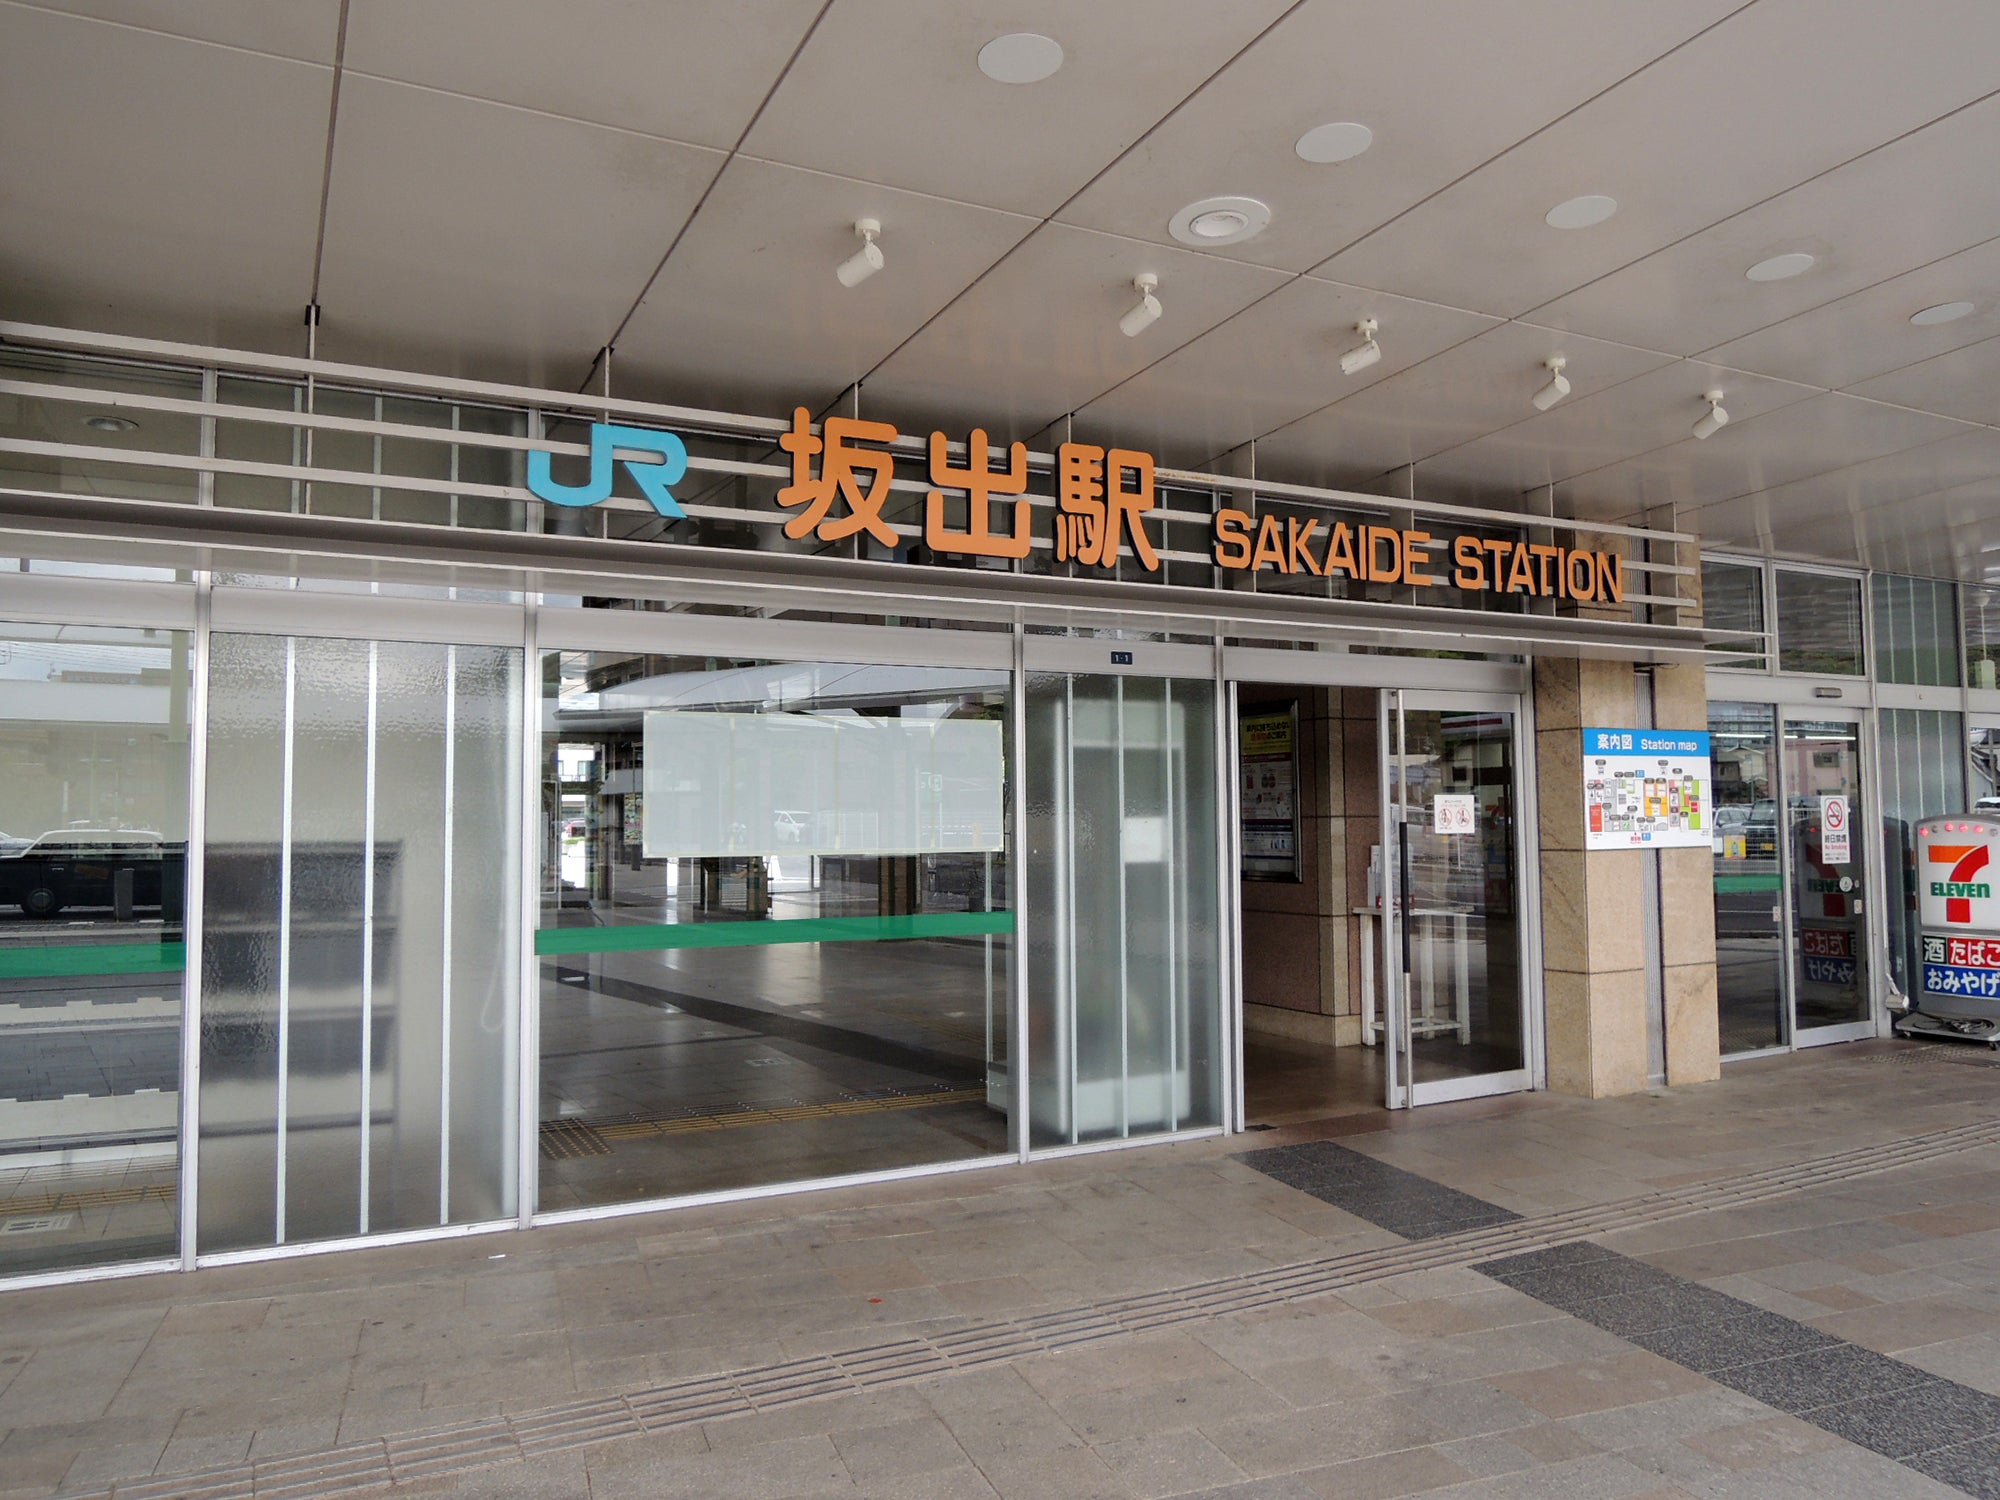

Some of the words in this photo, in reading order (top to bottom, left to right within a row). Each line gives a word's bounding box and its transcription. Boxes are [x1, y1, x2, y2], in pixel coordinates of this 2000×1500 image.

[527, 423, 688, 519] JR
[775, 406, 1160, 572] 坂出駅
[1213, 508, 1432, 586] SAKAIDE
[1452, 535, 1622, 603] STATION
[1597, 734, 1632, 750] 案内図
[1641, 739, 1676, 750] Station
[1678, 742, 1697, 752] map
[1924, 937, 1946, 963] 酒
[1950, 940, 2000, 967] たばこ
[1927, 967, 2000, 996] おみやげ
